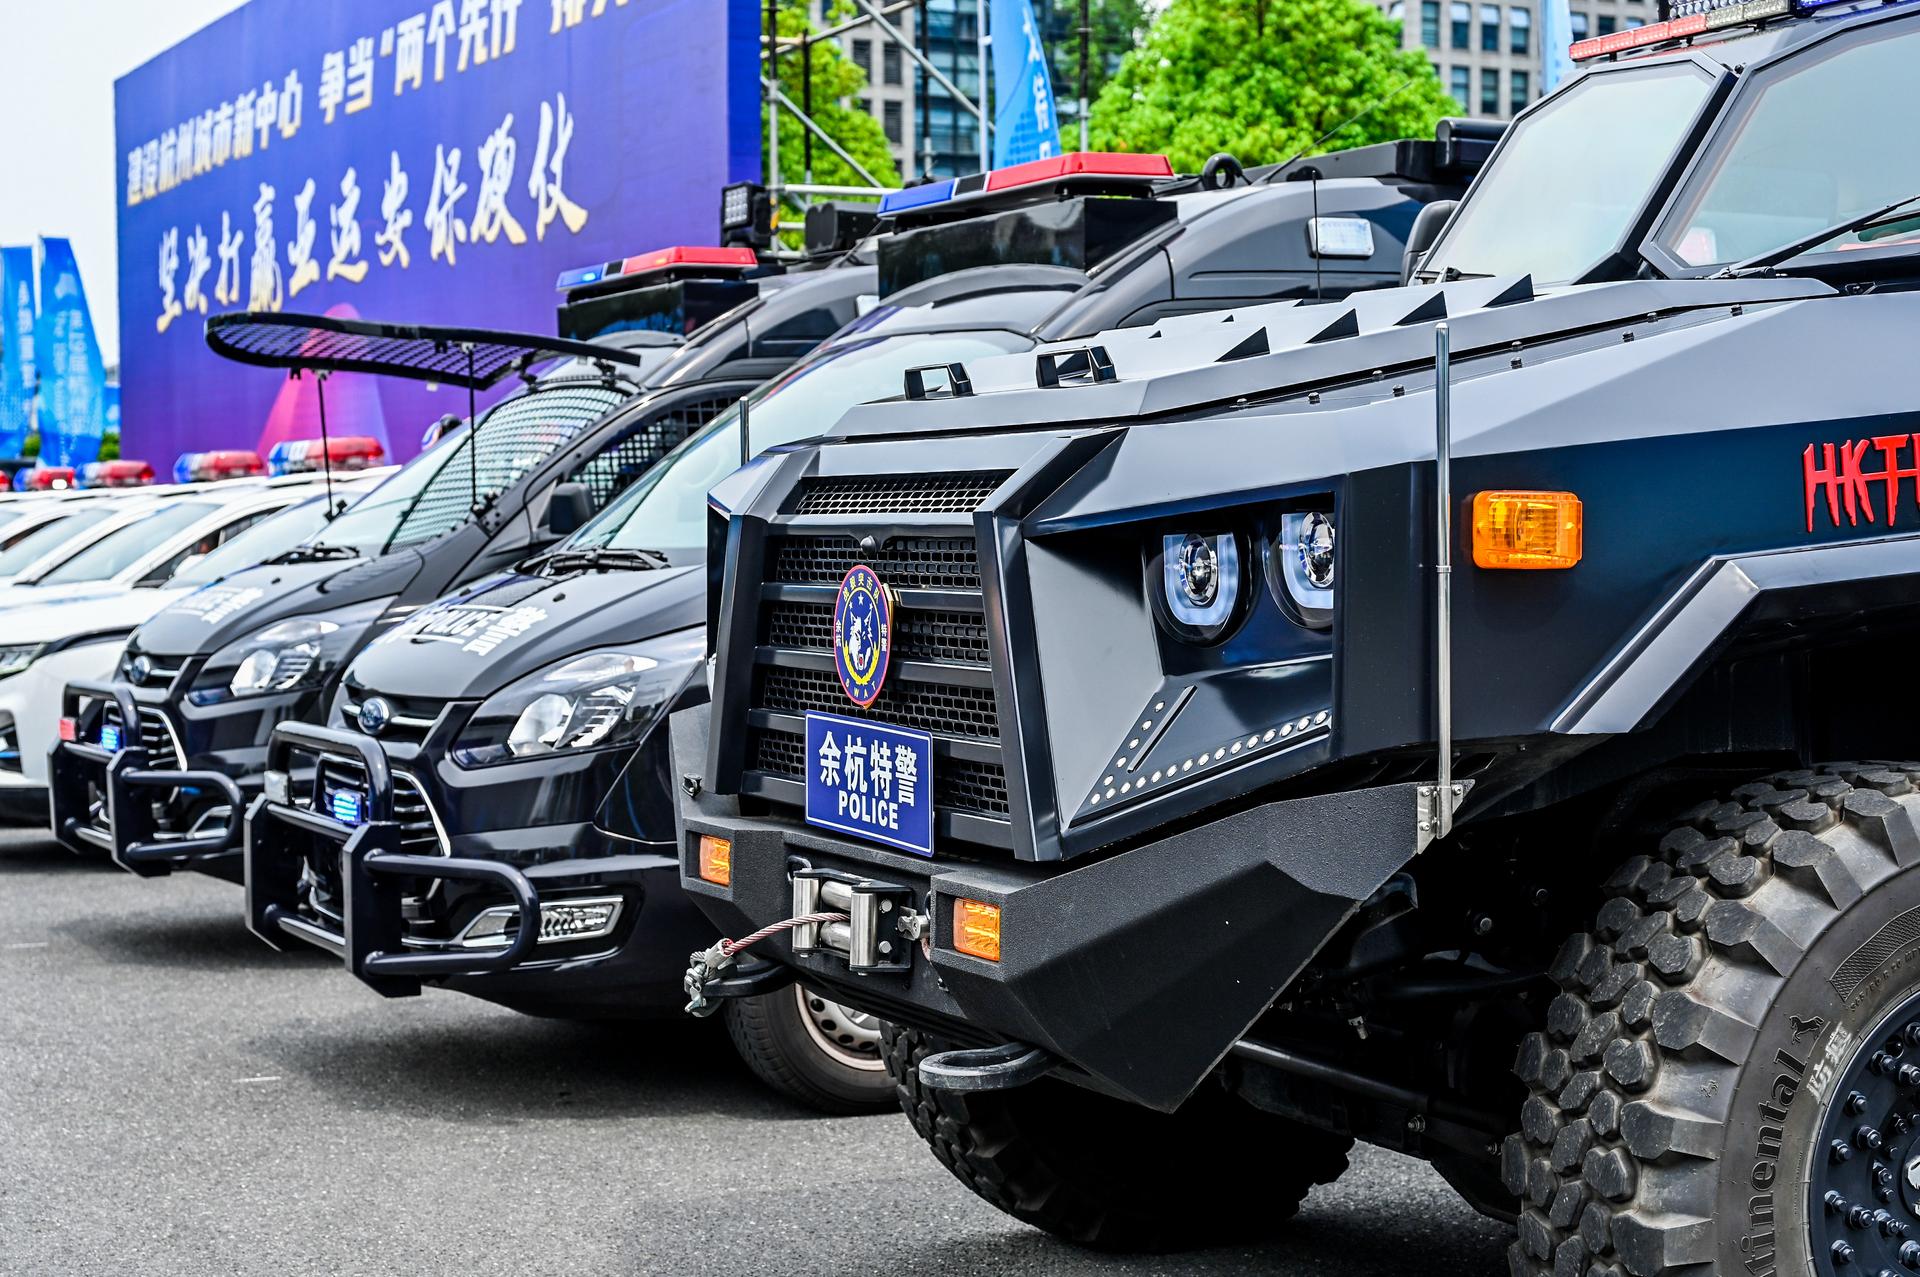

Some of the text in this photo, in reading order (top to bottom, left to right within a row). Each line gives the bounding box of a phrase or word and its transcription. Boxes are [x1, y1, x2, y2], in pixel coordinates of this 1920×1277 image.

[1803, 432, 1920, 533] HKT
[845, 678, 877, 699] SWAT
[818, 730, 918, 807] 余杭特警
[838, 789, 899, 830] POLICE
